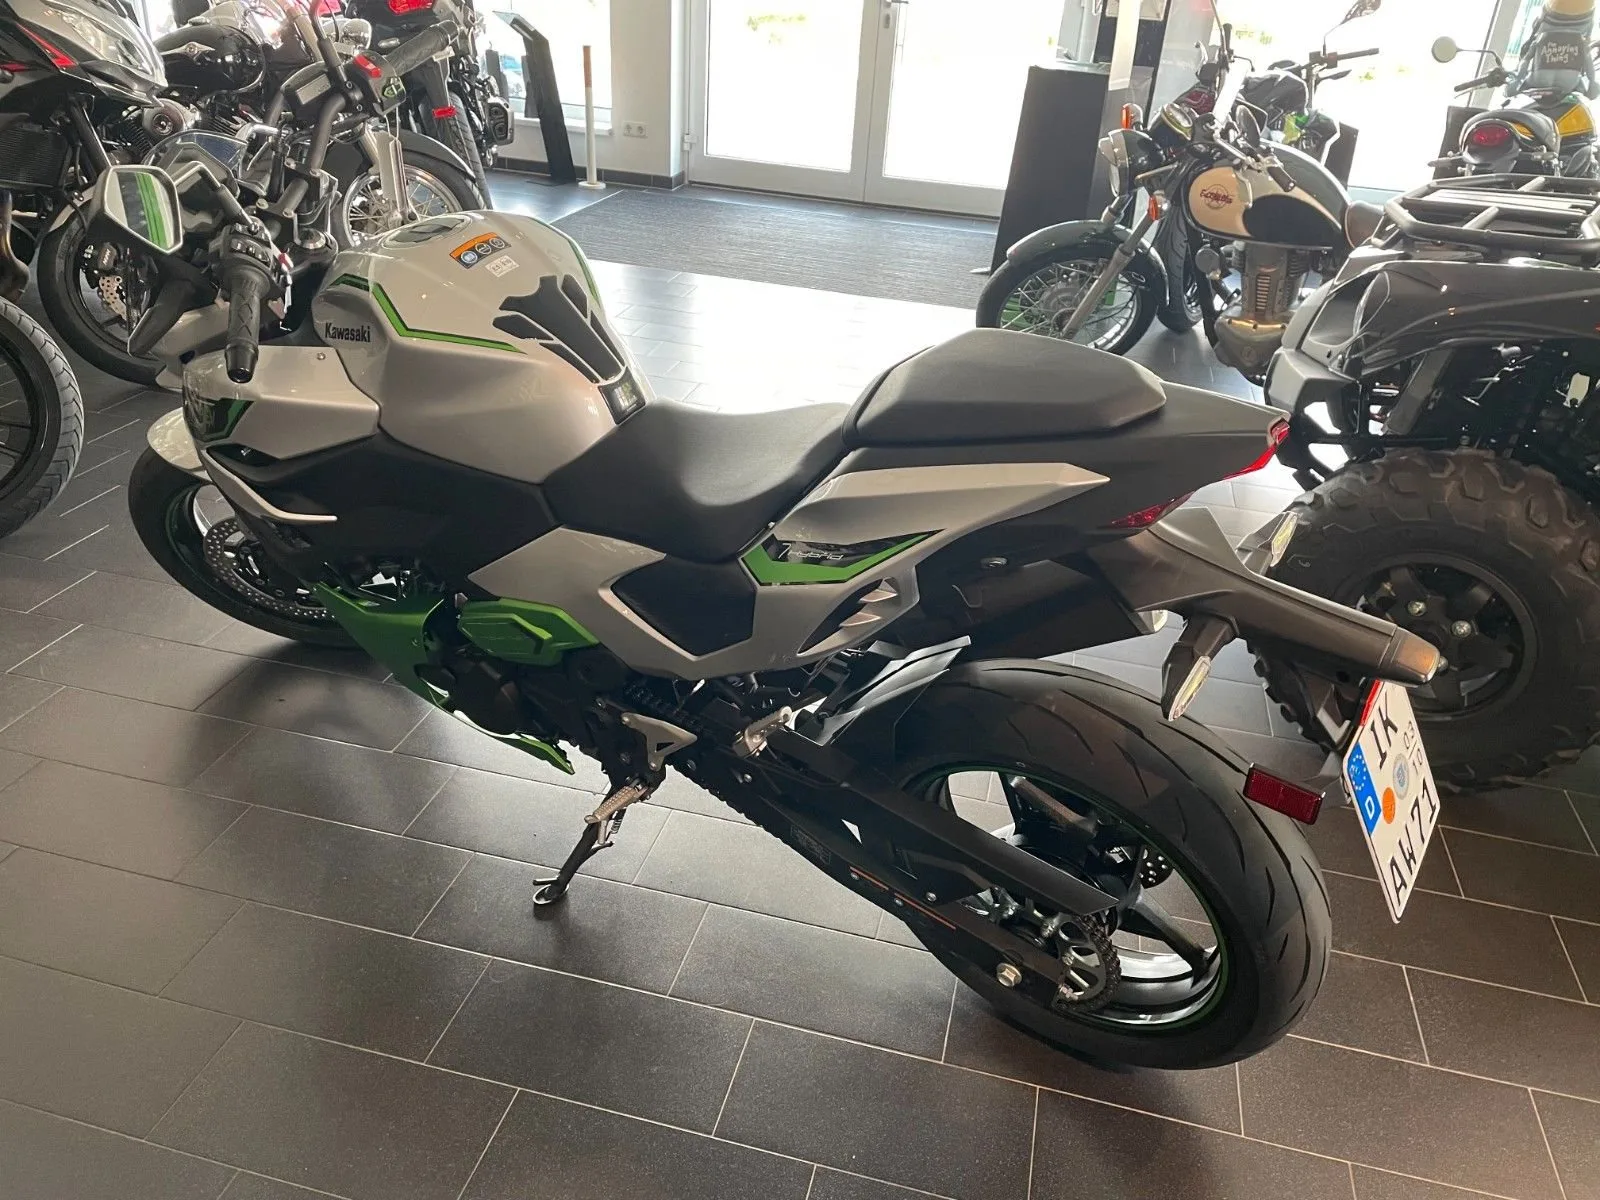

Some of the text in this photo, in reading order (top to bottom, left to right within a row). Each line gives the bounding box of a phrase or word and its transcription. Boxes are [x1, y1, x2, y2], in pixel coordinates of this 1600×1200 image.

[1541, 44, 1579, 56] Annoying
[1546, 53, 1569, 64] Thing
[325, 322, 371, 343] Kawasaki
[788, 550, 844, 561] Hybrid
[1371, 690, 1398, 770] IK
[1403, 721, 1415, 750] 03
[1412, 748, 1423, 776] 10
[1364, 795, 1376, 820] D
